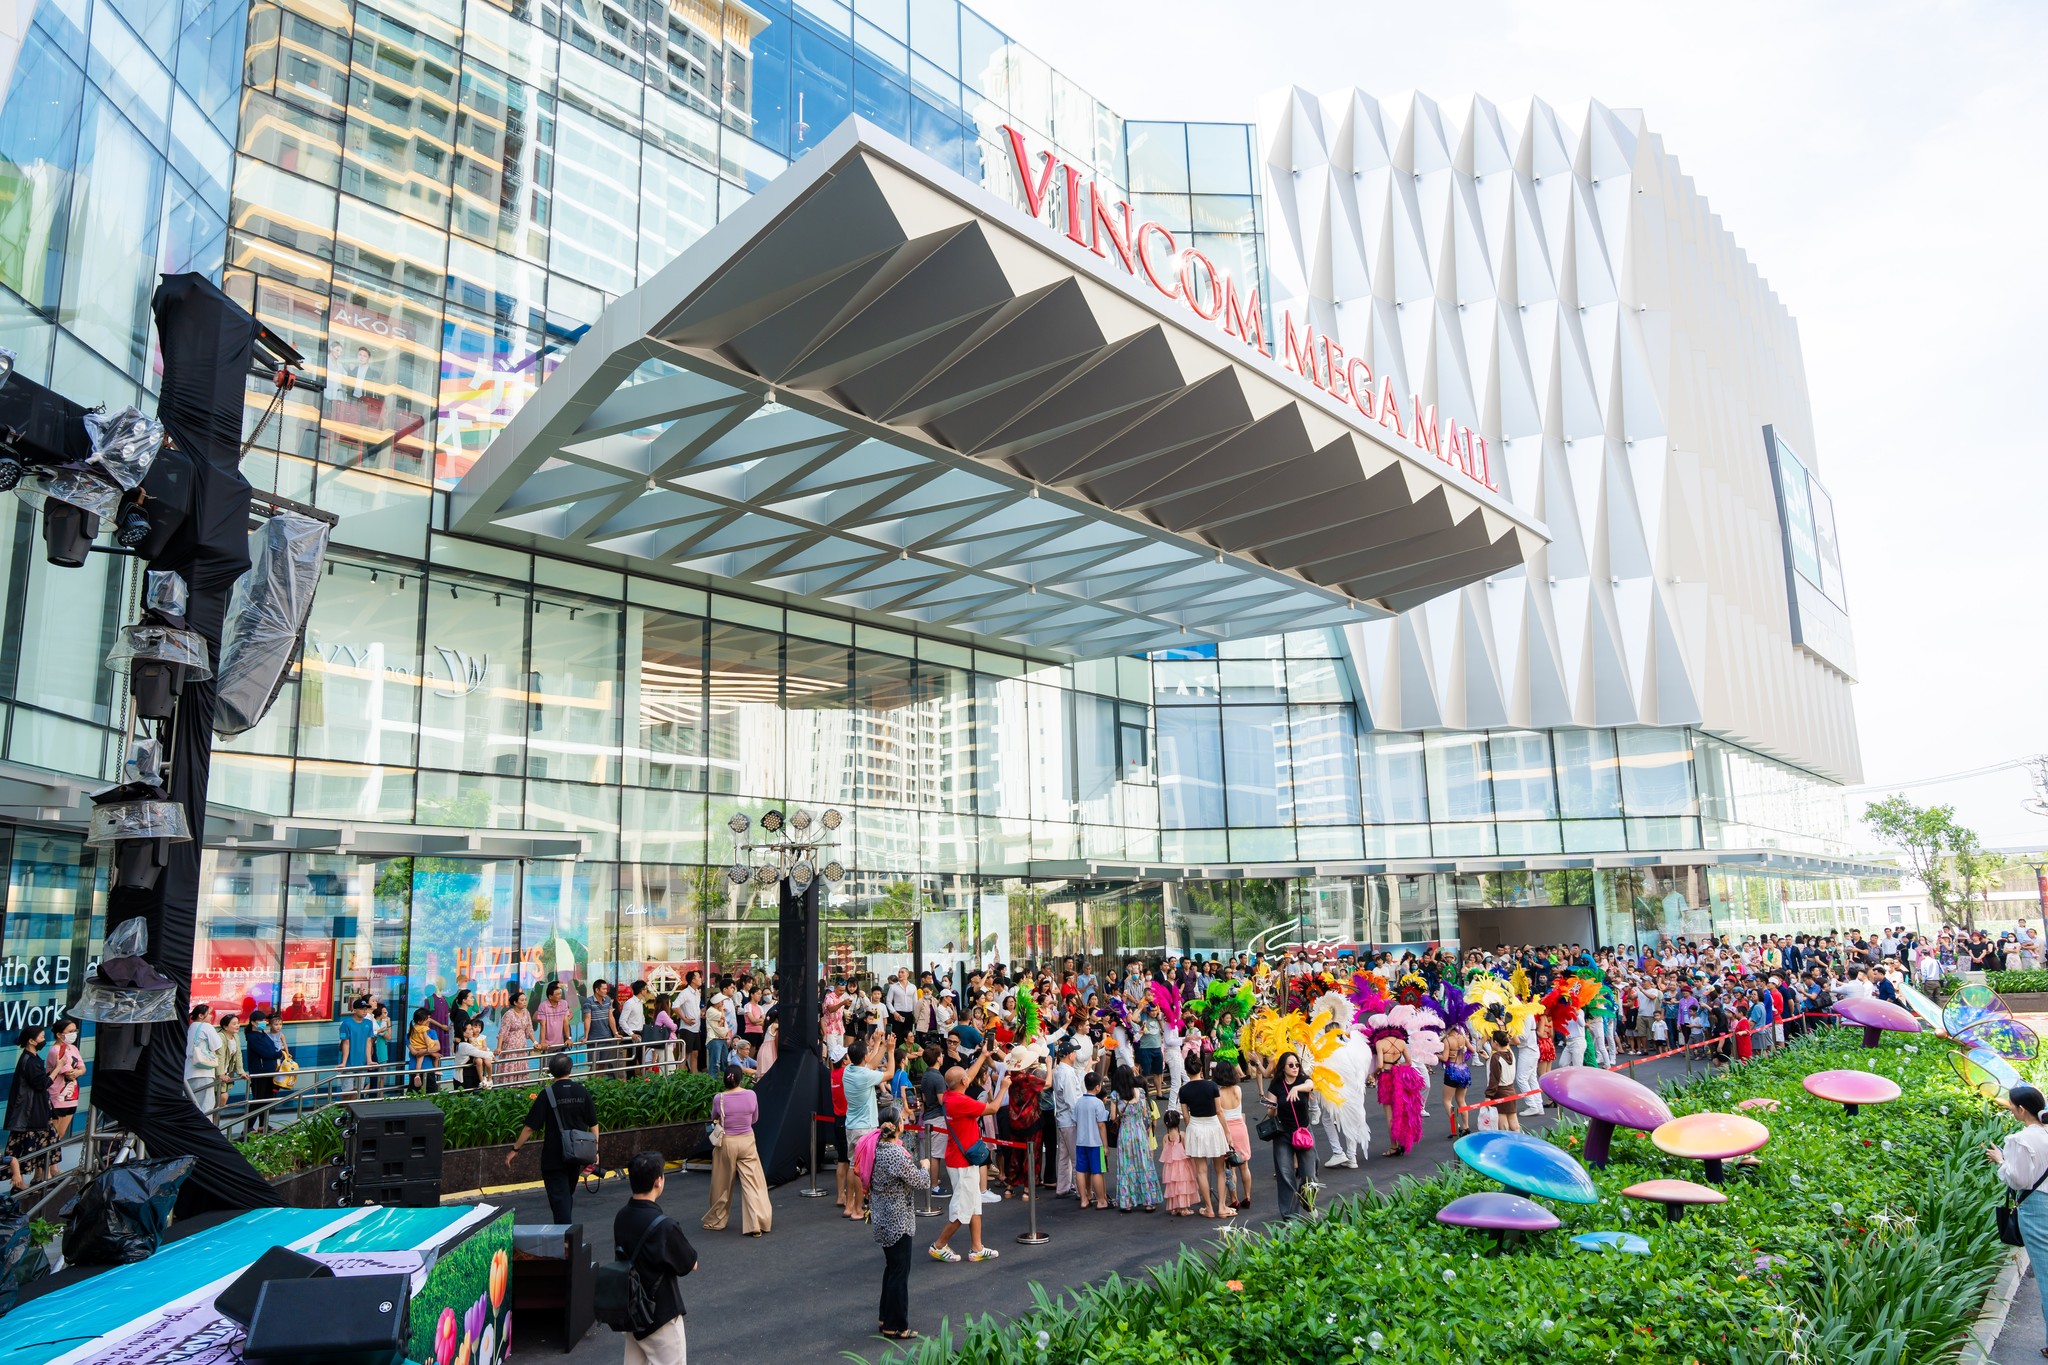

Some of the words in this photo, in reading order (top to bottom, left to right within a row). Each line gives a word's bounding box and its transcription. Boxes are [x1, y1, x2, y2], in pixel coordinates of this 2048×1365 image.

[1002, 123, 1274, 359] VINCOM
[1283, 311, 1408, 440] MEGA
[1413, 394, 1500, 493] MALL
[304, 642, 370, 673] VY
[33, 955, 50, 985] &
[194, 964, 278, 980] LUMINOU
[3, 998, 67, 1031] Work
